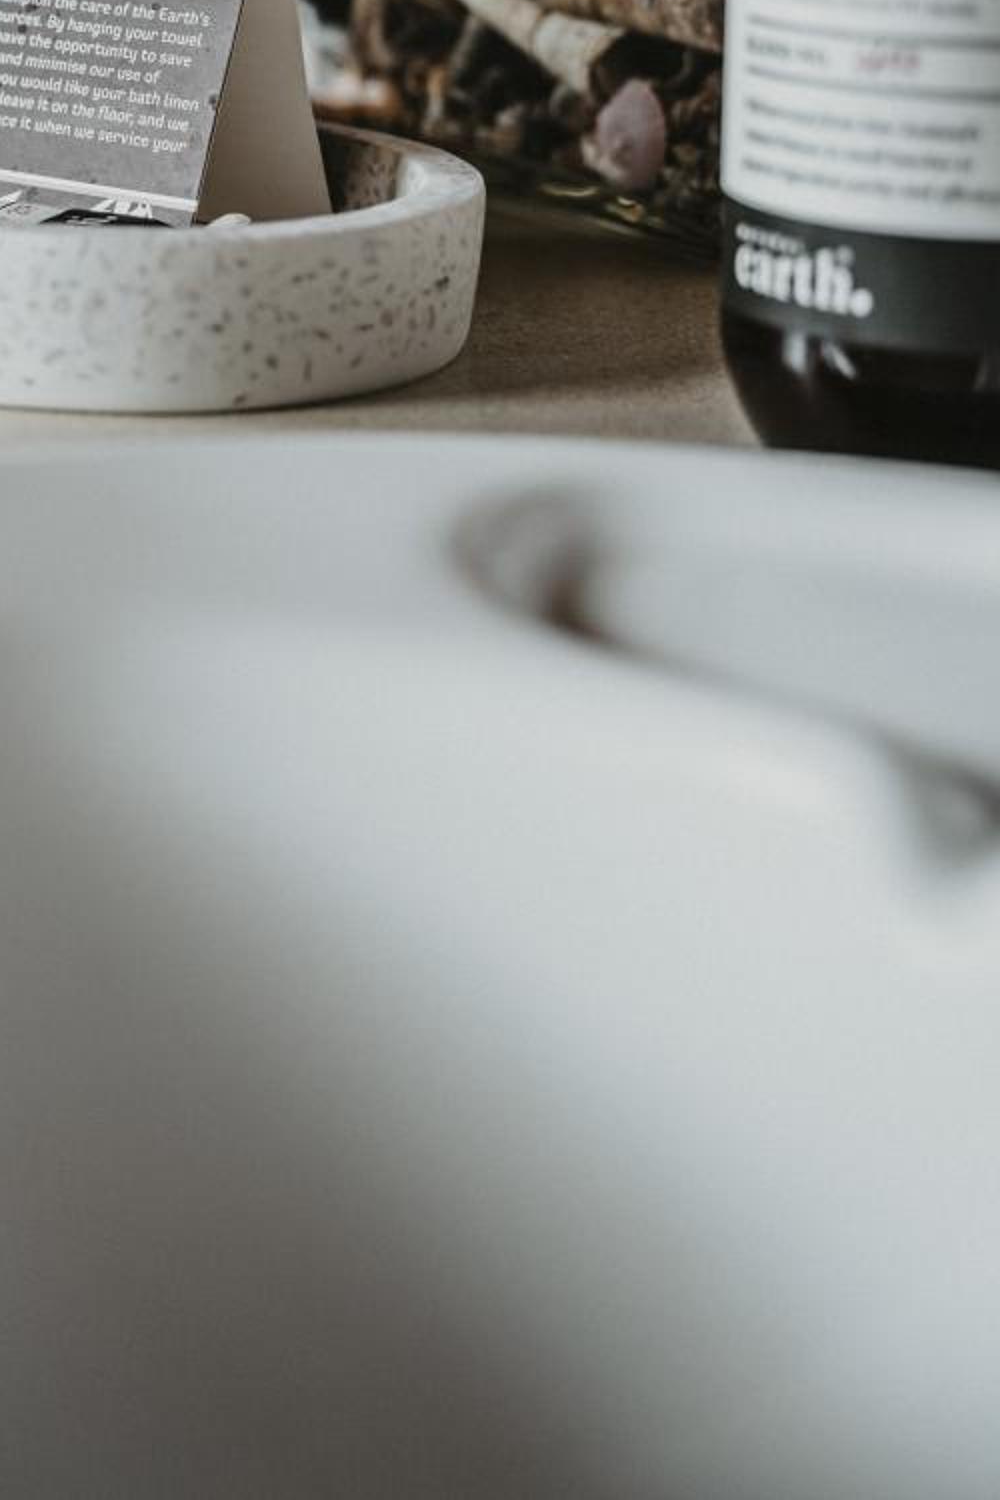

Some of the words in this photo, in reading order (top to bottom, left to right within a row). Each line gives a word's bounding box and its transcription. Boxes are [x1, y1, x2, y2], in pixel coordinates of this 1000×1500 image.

[80, 0, 110, 15] care
[114, 1, 131, 16] of
[132, 5, 155, 20] the
[159, 7, 211, 26] Earth's
[47, 14, 65, 33] By
[67, 17, 122, 41] hanging
[124, 27, 159, 42] your
[161, 31, 203, 48] towel
[29, 33, 52, 49] the
[54, 37, 139, 64] opportunity
[141, 49, 157, 63] to
[159, 53, 192, 68] save
[25, 55, 87, 76] minimise
[89, 64, 115, 78] our
[117, 69, 141, 82] use
[143, 69, 163, 84] of
[19, 76, 63, 92] would
[64, 79, 90, 96] like
[92, 86, 126, 101] your
[128, 88, 161, 105] bath
[163, 93, 201, 111] linen
[0, 91, 35, 110] leave
[37, 97, 49, 111] it
[51, 101, 69, 114] on
[71, 103, 95, 119] the
[98, 105, 134, 127] floor,
[137, 113, 166, 129] and
[167, 119, 190, 132] we
[19, 116, 32, 130] it
[34, 119, 71, 136] when
[74, 126, 95, 139] we
[98, 129, 150, 149] service
[152, 138, 187, 153] your
